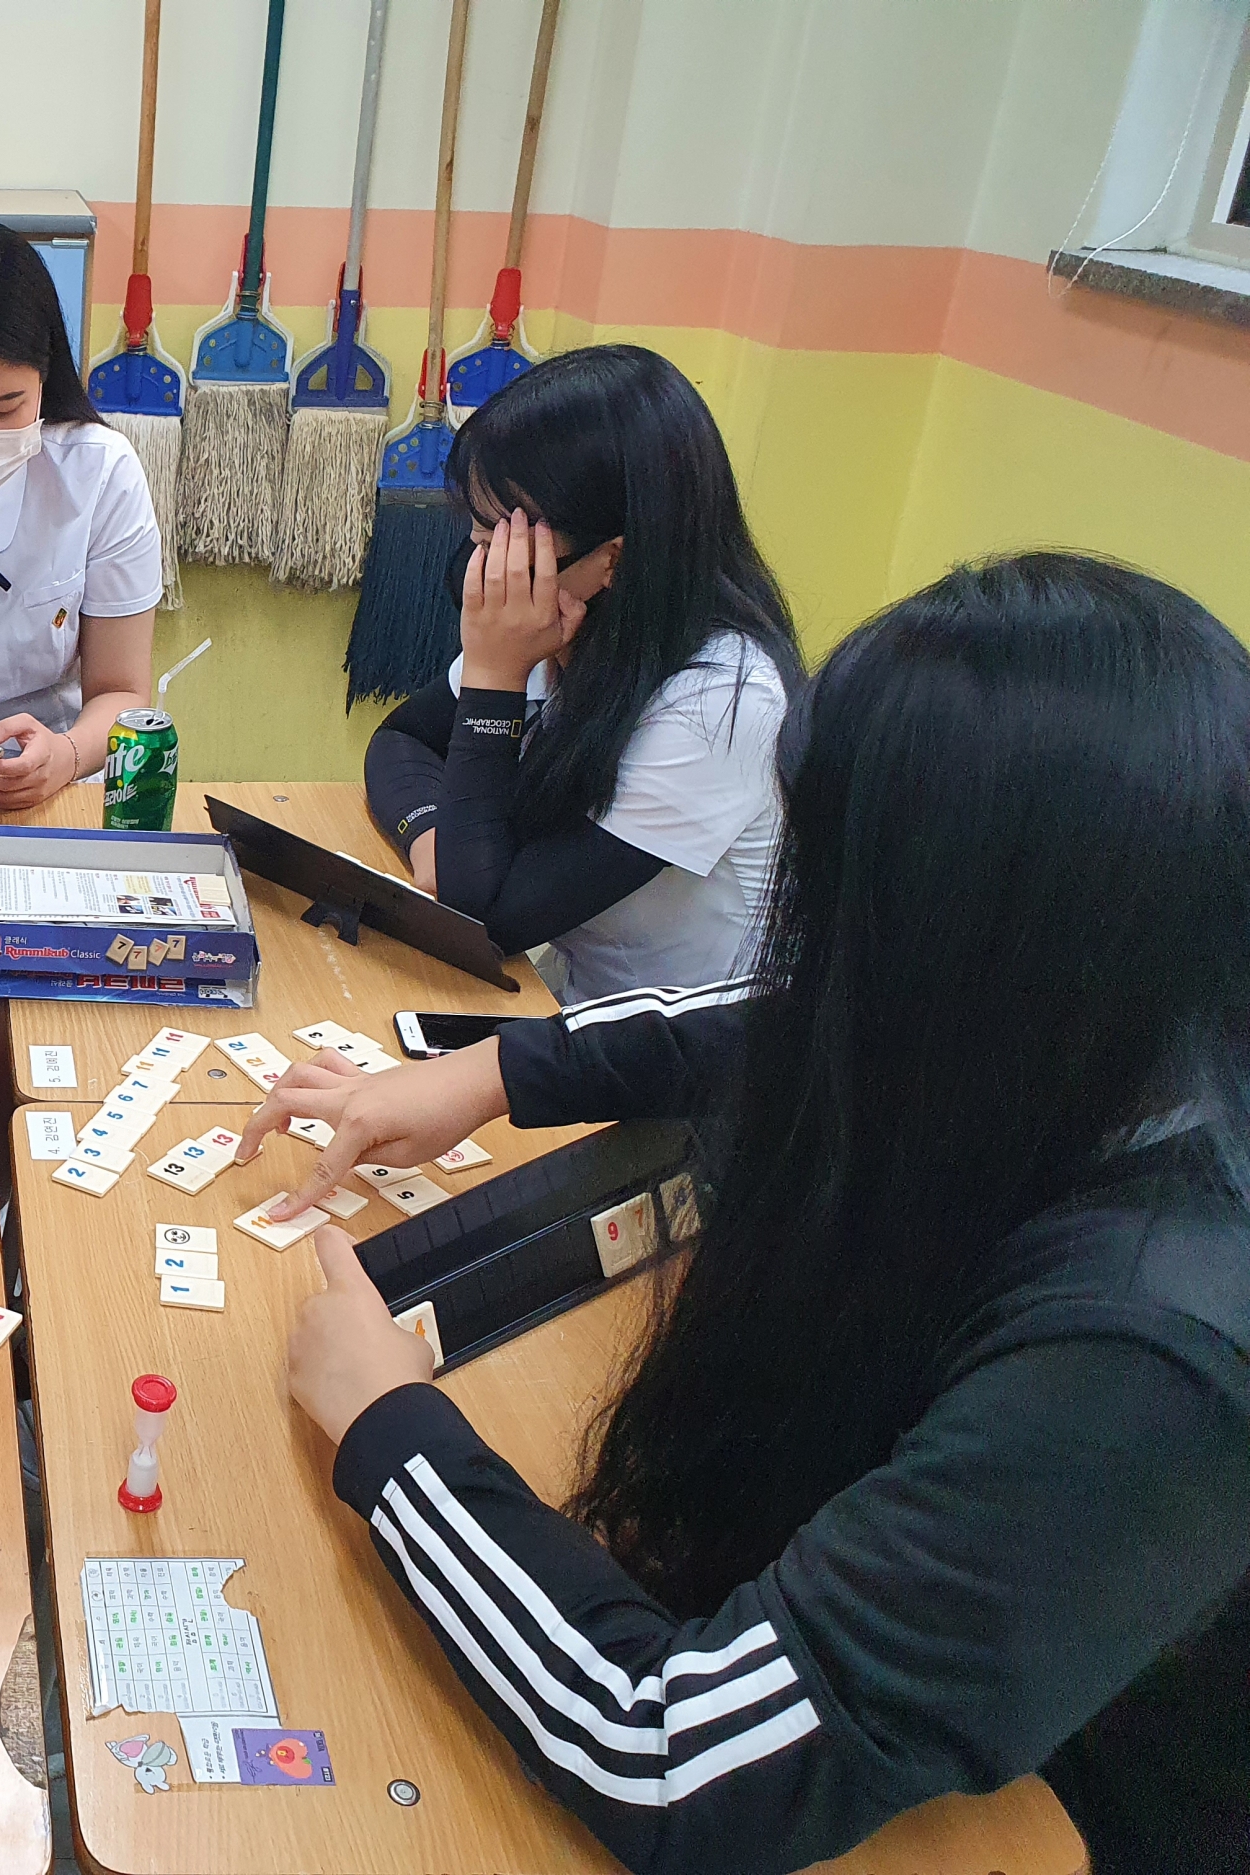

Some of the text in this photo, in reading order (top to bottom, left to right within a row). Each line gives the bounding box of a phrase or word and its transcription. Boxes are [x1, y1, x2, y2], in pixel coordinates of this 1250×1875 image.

[473, 726, 509, 735] NATIONAL
[4, 936, 28, 945] 클래식
[117, 941, 126, 949] 7
[172, 940, 179, 948] 7
[5, 945, 101, 960] Rummikub Classic
[133, 951, 141, 959] 7
[166, 1033, 183, 1042] 11
[309, 1031, 323, 1039] 3
[229, 1041, 248, 1051] 12
[338, 1043, 354, 1052] 2
[152, 1047, 171, 1057] 11
[136, 1060, 155, 1071] 11
[246, 1056, 266, 1068] 12
[132, 1080, 148, 1089] 7
[118, 1094, 134, 1102] 6
[107, 1111, 124, 1120] 5
[43, 1117, 59, 1141] 김연진
[92, 1127, 109, 1137] 4
[300, 1123, 316, 1133] 7
[212, 1134, 233, 1146] 13
[84, 1148, 101, 1157] 3
[184, 1146, 205, 1159] 13
[68, 1167, 86, 1178] 2
[164, 1162, 185, 1176] 13
[372, 1168, 388, 1177] 6
[397, 1190, 415, 1200] 5
[607, 1222, 618, 1241] 9
[165, 1258, 184, 1268] 2
[171, 1285, 190, 1293] 1
